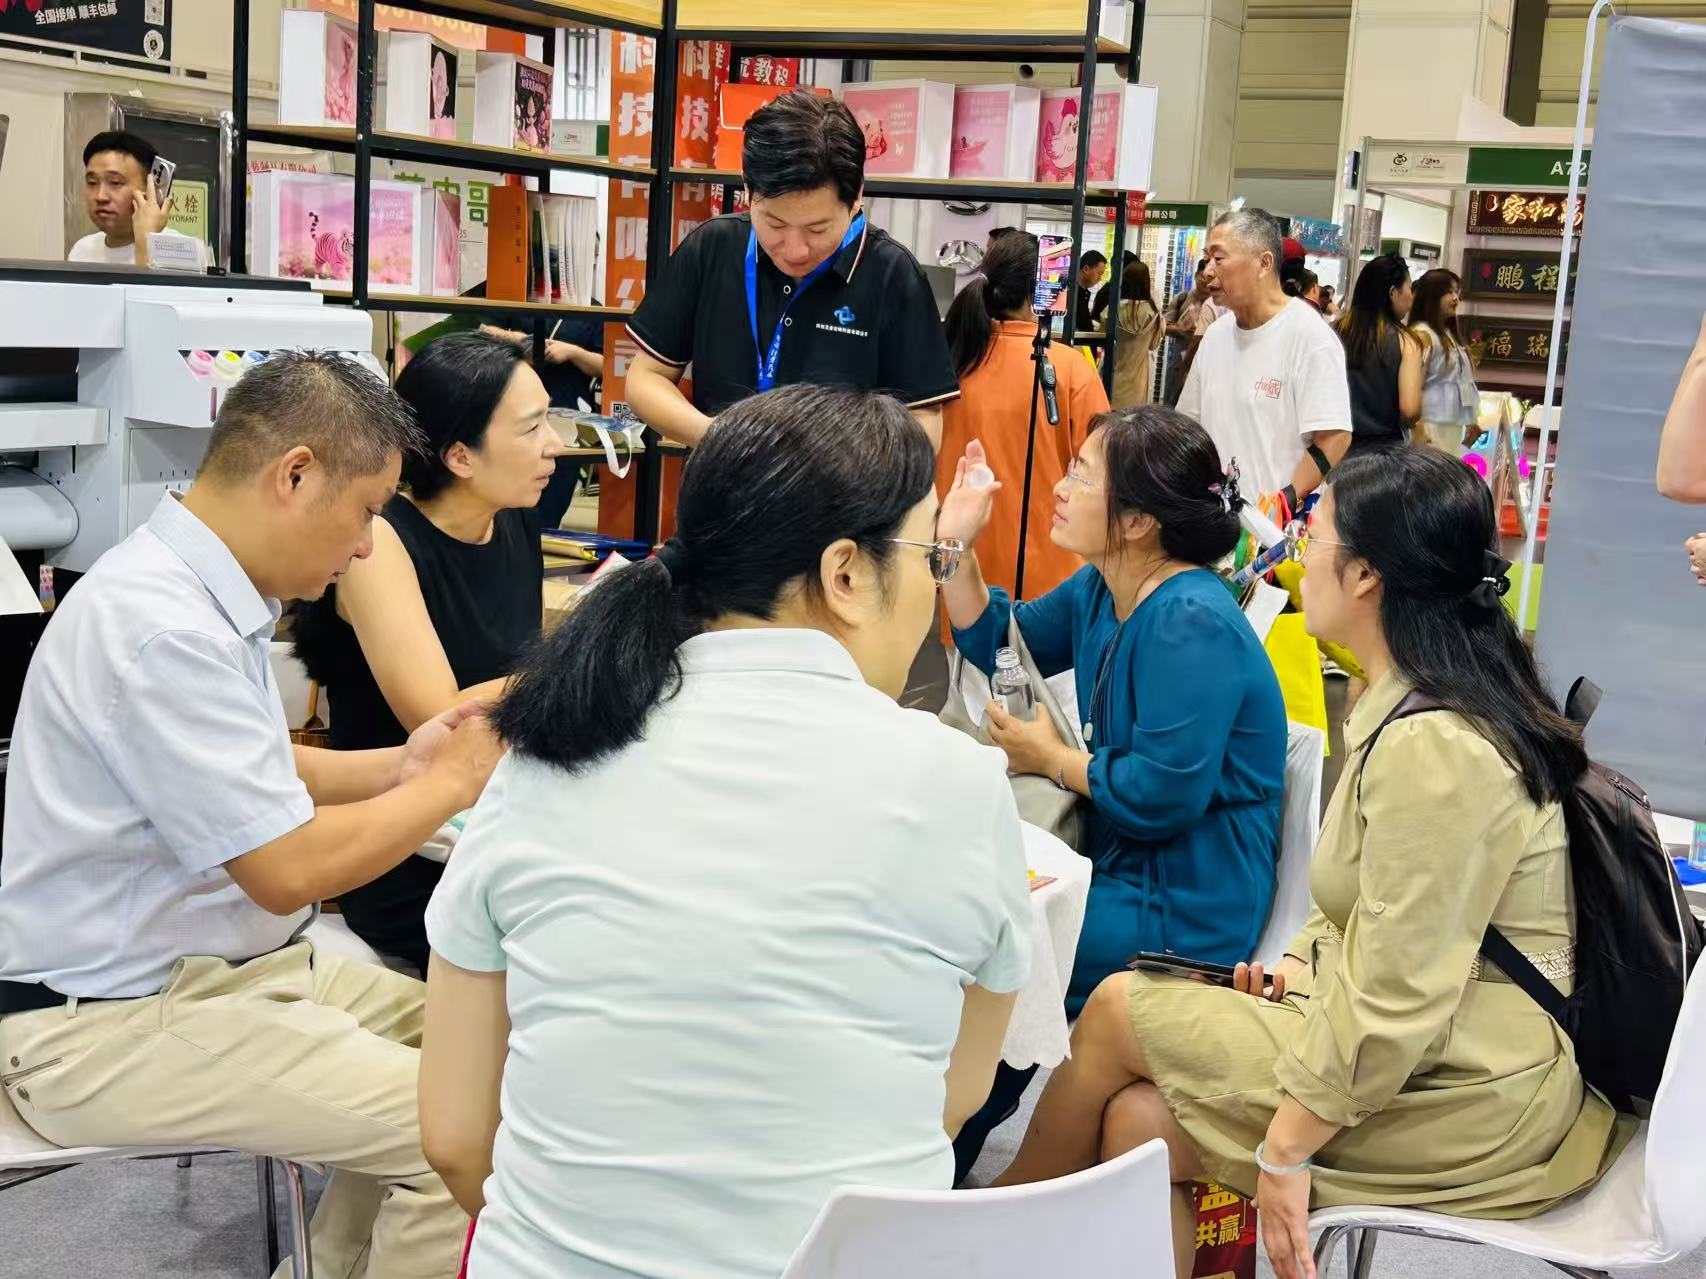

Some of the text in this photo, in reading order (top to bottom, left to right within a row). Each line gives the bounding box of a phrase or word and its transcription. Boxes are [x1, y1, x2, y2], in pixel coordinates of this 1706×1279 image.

[34, 2, 117, 25] 全国接单 顺丰包邮
[1196, 1213, 1241, 1250] 共赢
